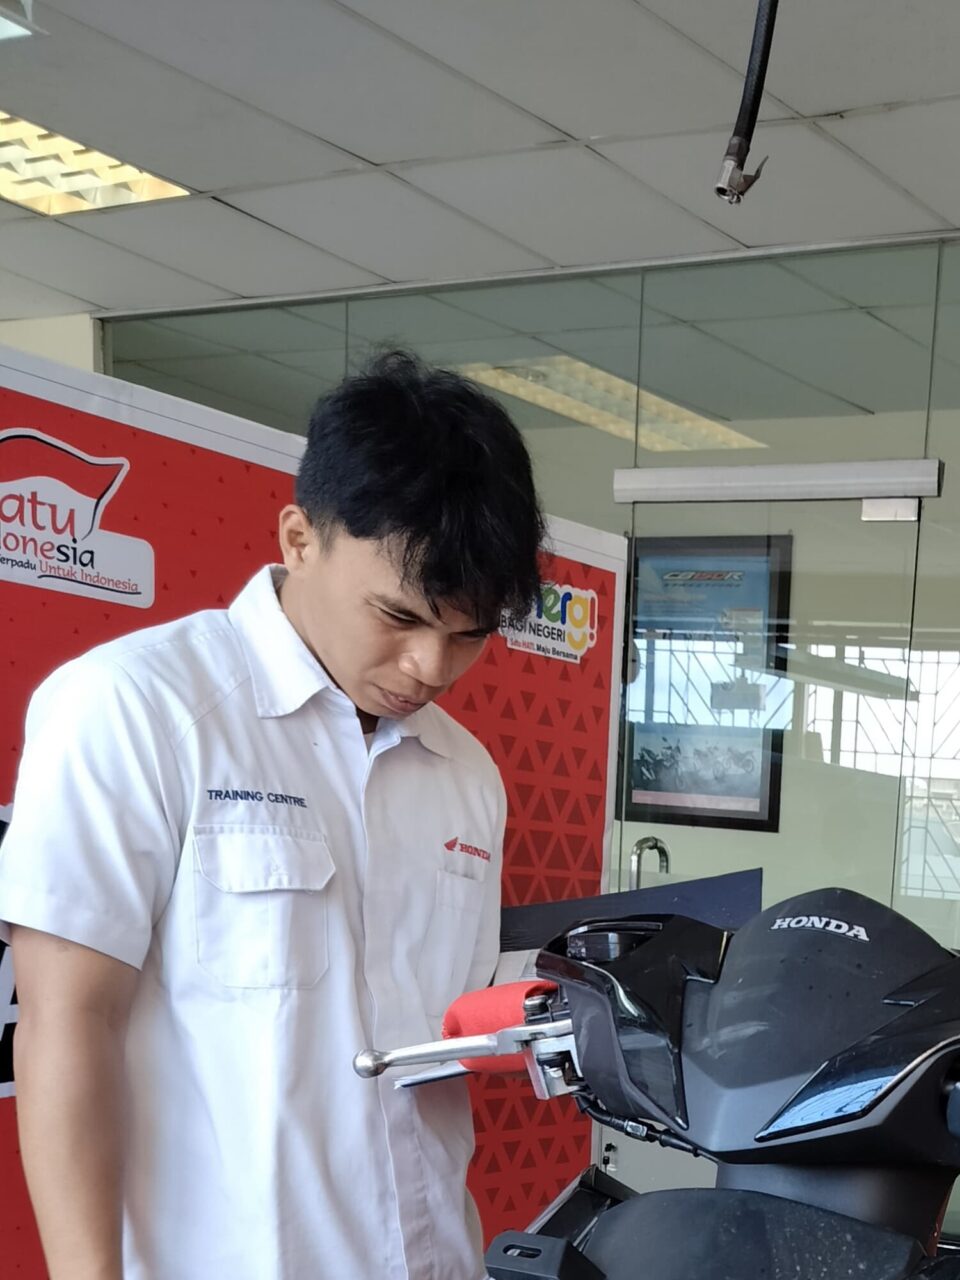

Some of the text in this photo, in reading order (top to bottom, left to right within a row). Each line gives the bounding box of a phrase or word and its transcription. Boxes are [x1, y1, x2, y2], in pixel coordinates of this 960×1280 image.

[0, 532, 95, 569] onesia
[0, 555, 139, 592] erpadu Untuk Indonesia
[528, 622, 566, 643] NEGERI
[207, 789, 308, 808] TRAINING CENTRE
[770, 916, 870, 942] HONDA
